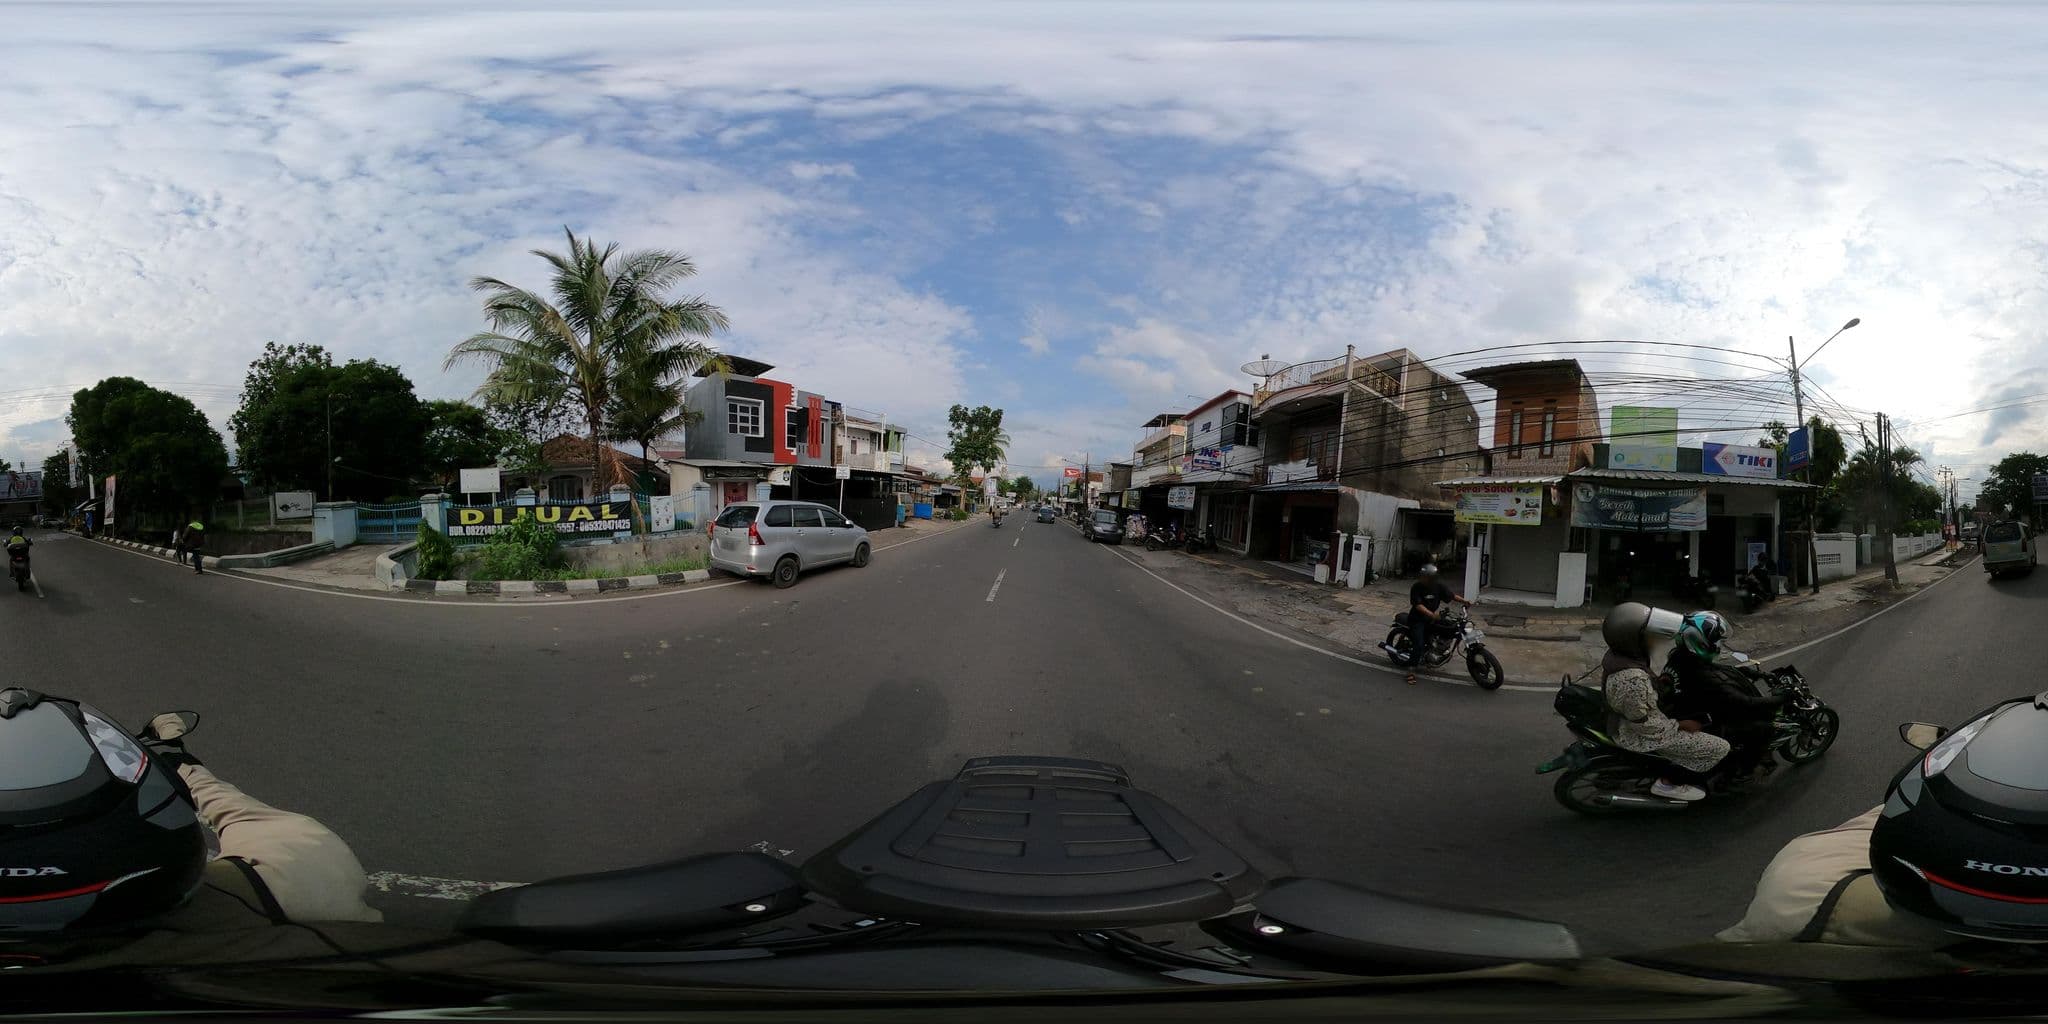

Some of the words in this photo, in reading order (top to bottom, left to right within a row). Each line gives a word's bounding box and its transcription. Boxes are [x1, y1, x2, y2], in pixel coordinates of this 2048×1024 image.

[1198, 446, 1221, 458] JNE
[1736, 454, 1772, 468] TIKI
[460, 504, 619, 525] DIJUAL
[0, 866, 69, 878] DA
